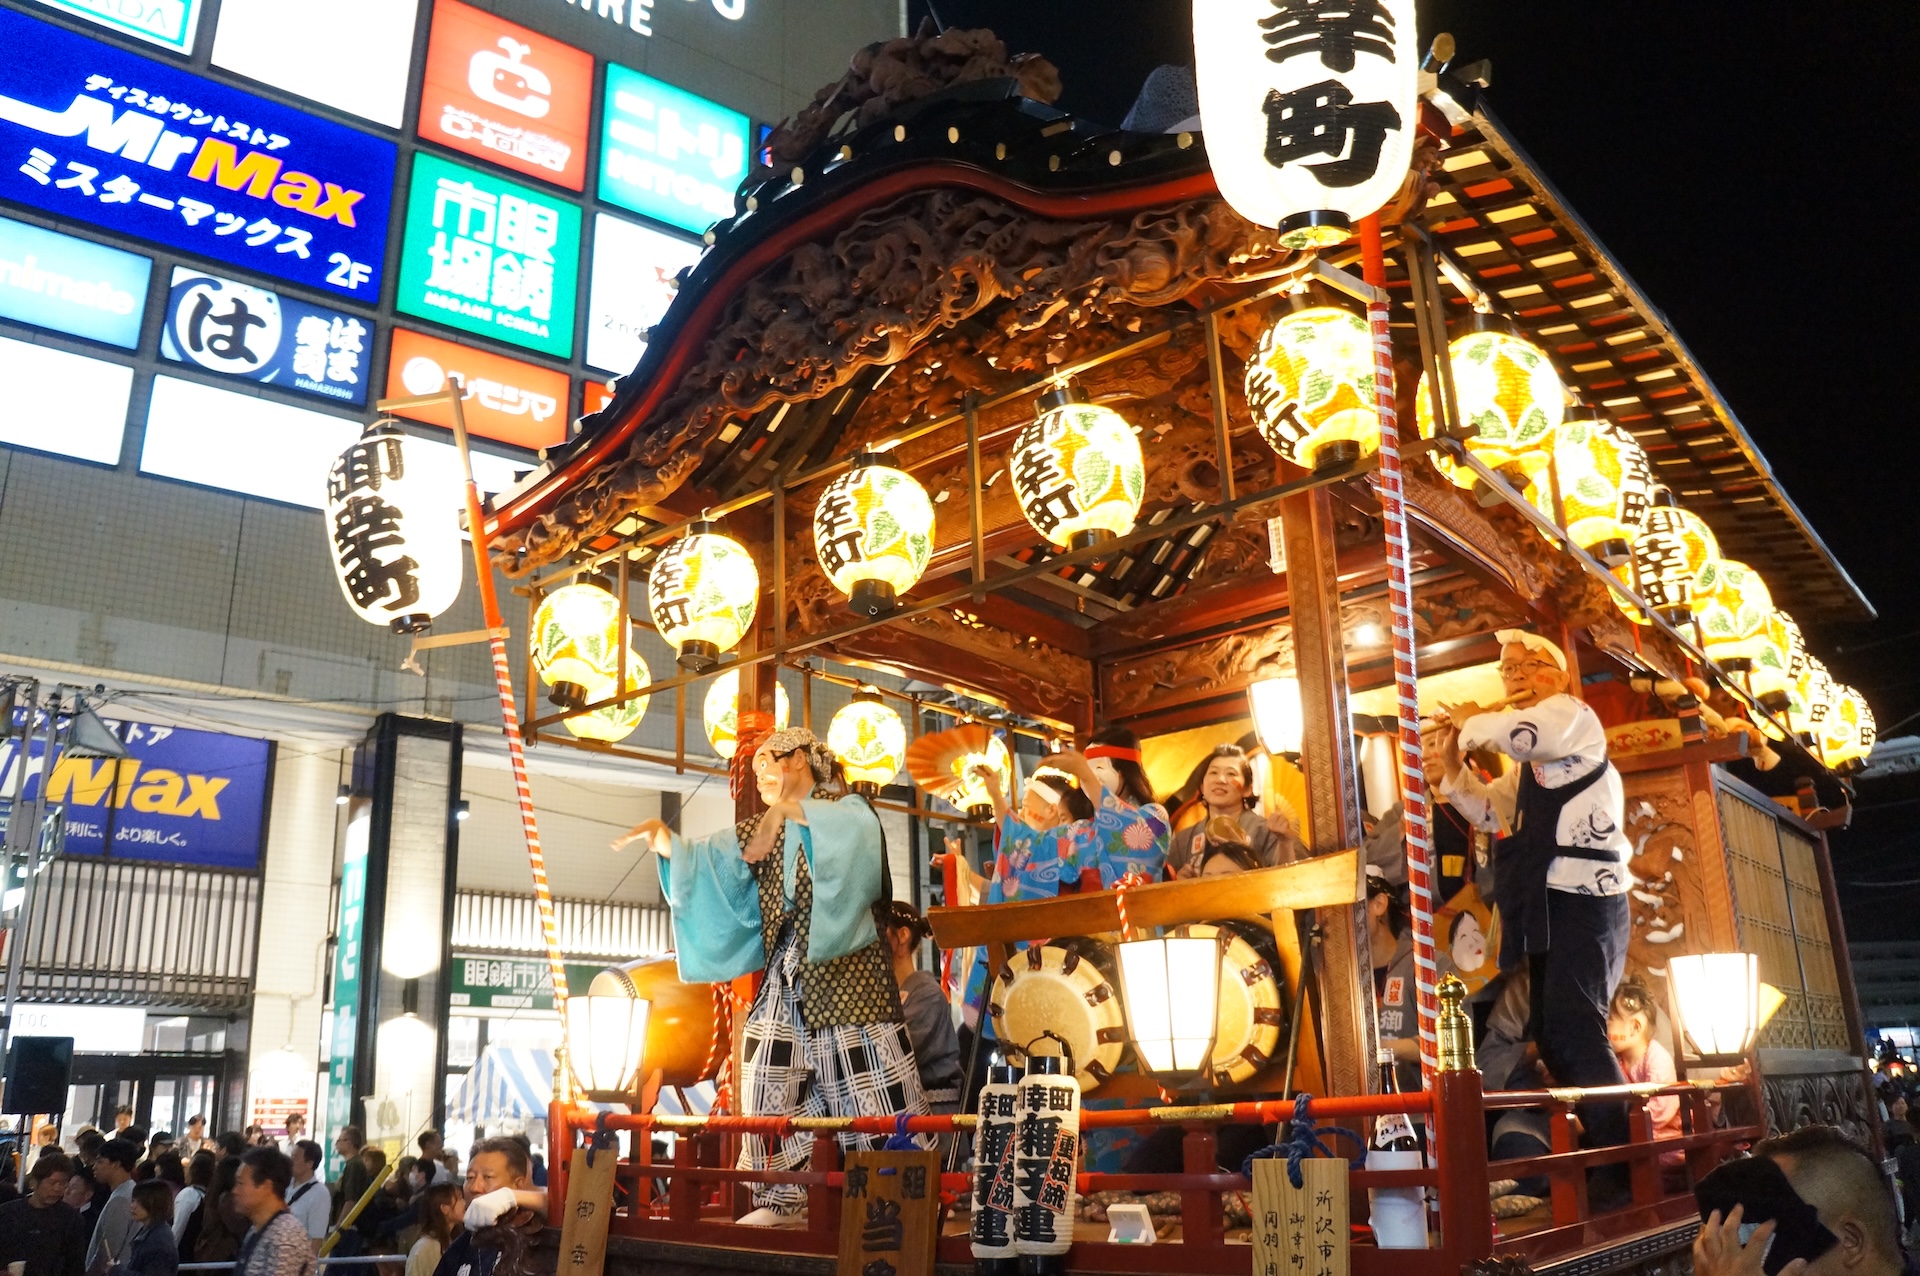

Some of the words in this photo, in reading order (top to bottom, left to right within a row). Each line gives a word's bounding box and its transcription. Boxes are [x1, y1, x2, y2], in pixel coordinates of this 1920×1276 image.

[84, 73, 292, 151] ディスカウントストア
[609, 89, 743, 179] ニトリ
[19, 146, 316, 261] ミスターマックス
[325, 252, 373, 290] 2F
[188, 292, 267, 365] は
[294, 377, 354, 400] HAMAZUSHI
[1012, 411, 1077, 536] 御幸町
[327, 437, 420, 612] 御幸町
[115, 826, 188, 848] より楽しく。
[1289, 1212, 1305, 1270] 御幸町
